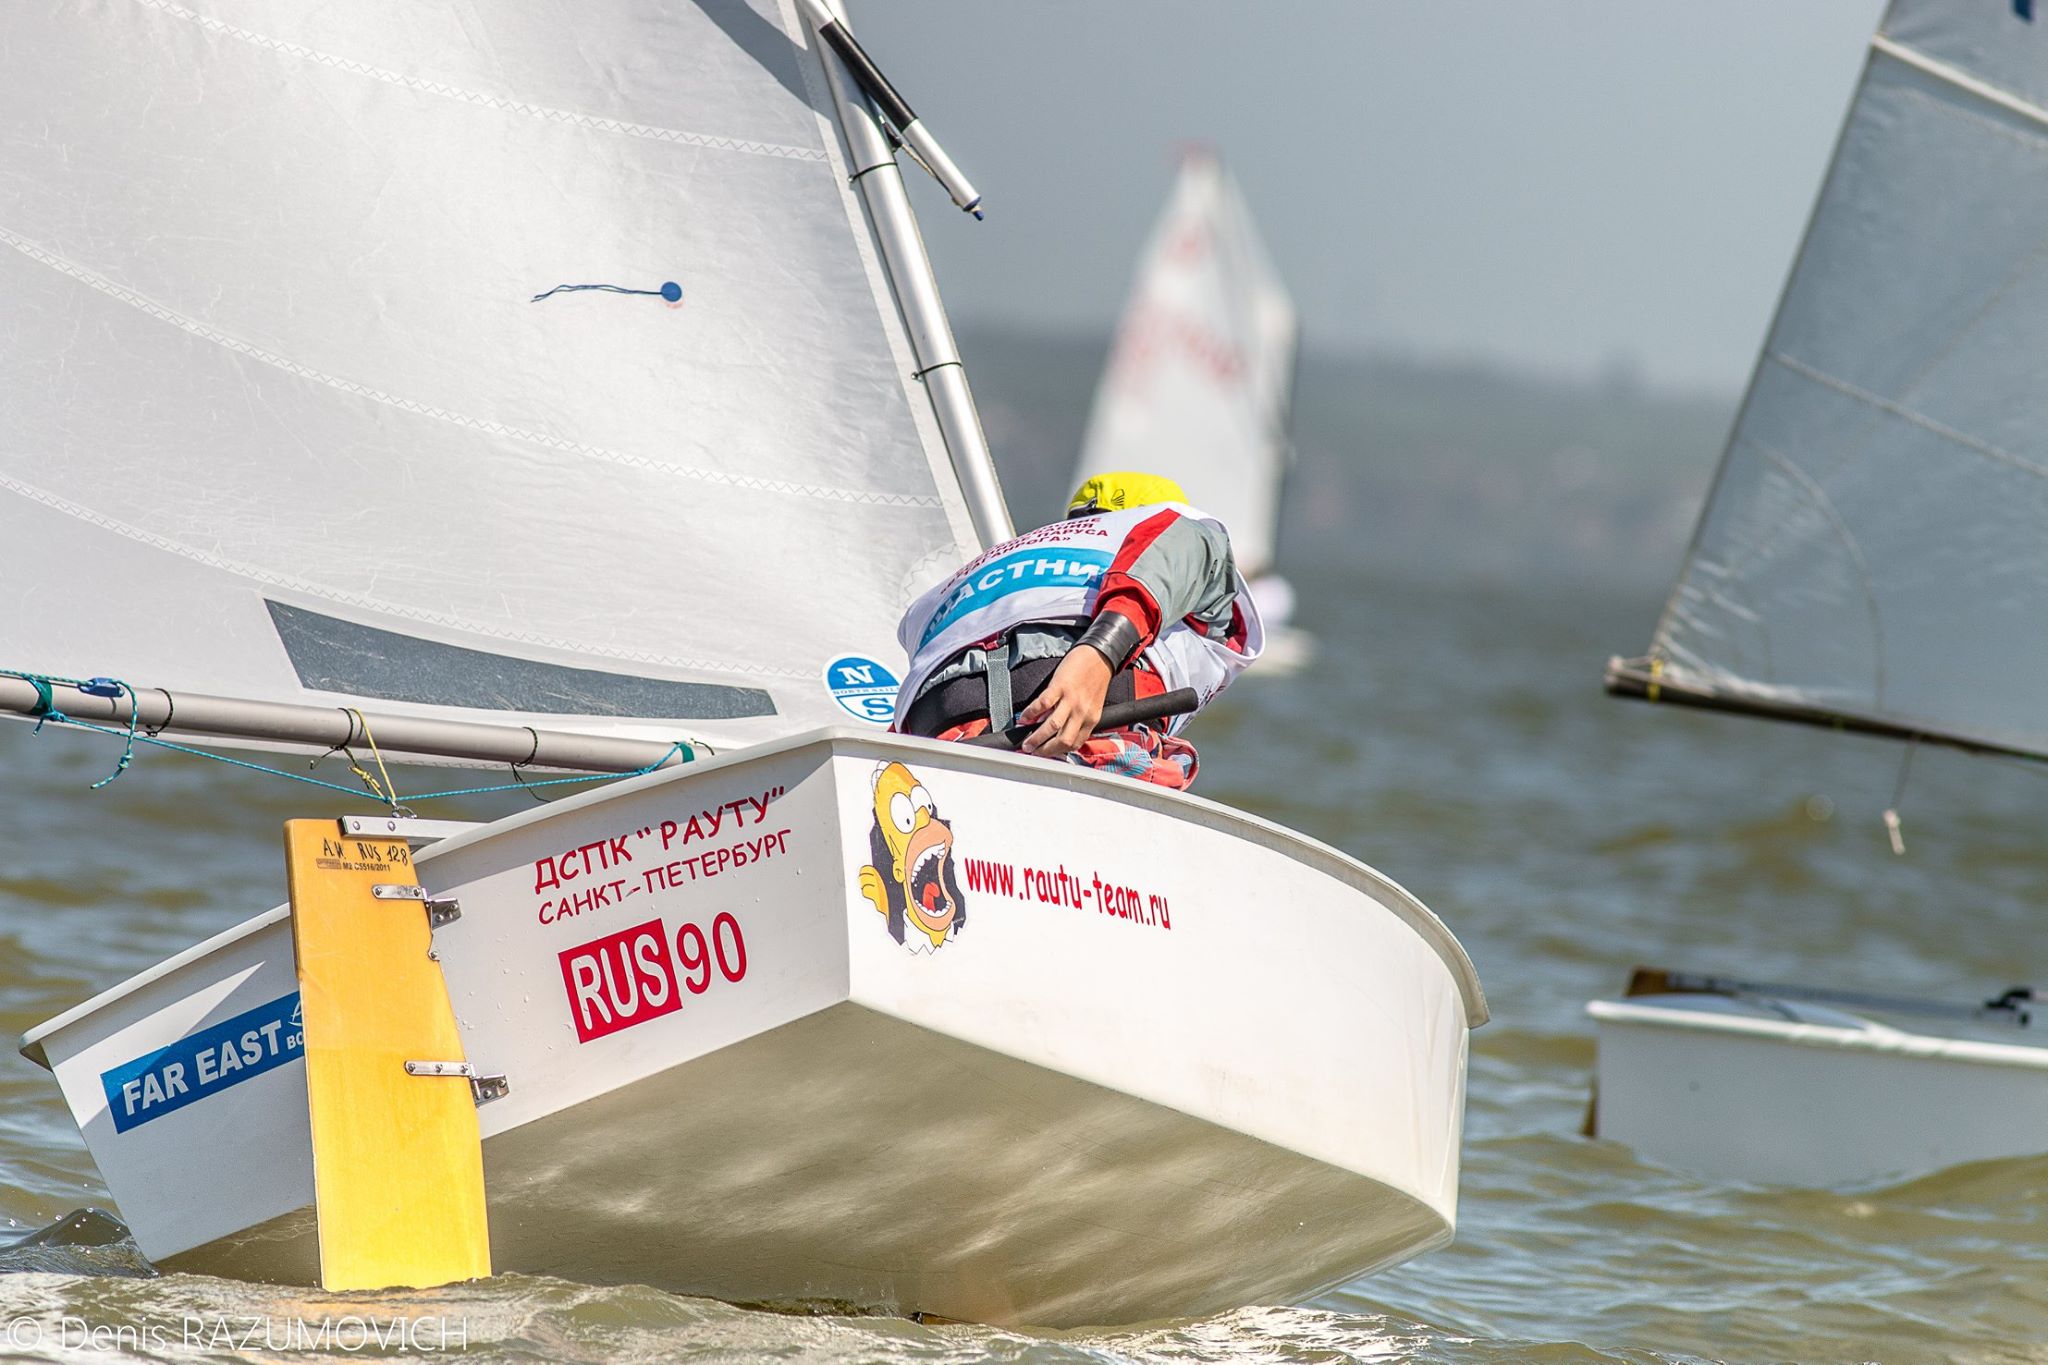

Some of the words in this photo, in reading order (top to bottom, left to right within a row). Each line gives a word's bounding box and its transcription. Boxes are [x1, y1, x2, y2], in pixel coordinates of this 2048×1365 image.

[837, 665, 875, 685] N
[862, 697, 895, 716] S
[357, 842, 381, 862] RUS
[387, 845, 408, 866] 128
[534, 834, 632, 895] ДСПК
[538, 828, 792, 925] САНКТ-ПЕТЕРБУРГ
[964, 857, 1172, 931] www.rautu-team.ru
[570, 933, 669, 1031] RUS
[675, 911, 748, 995] 90
[122, 1062, 190, 1117] FAR
[195, 1019, 282, 1086] EAST
